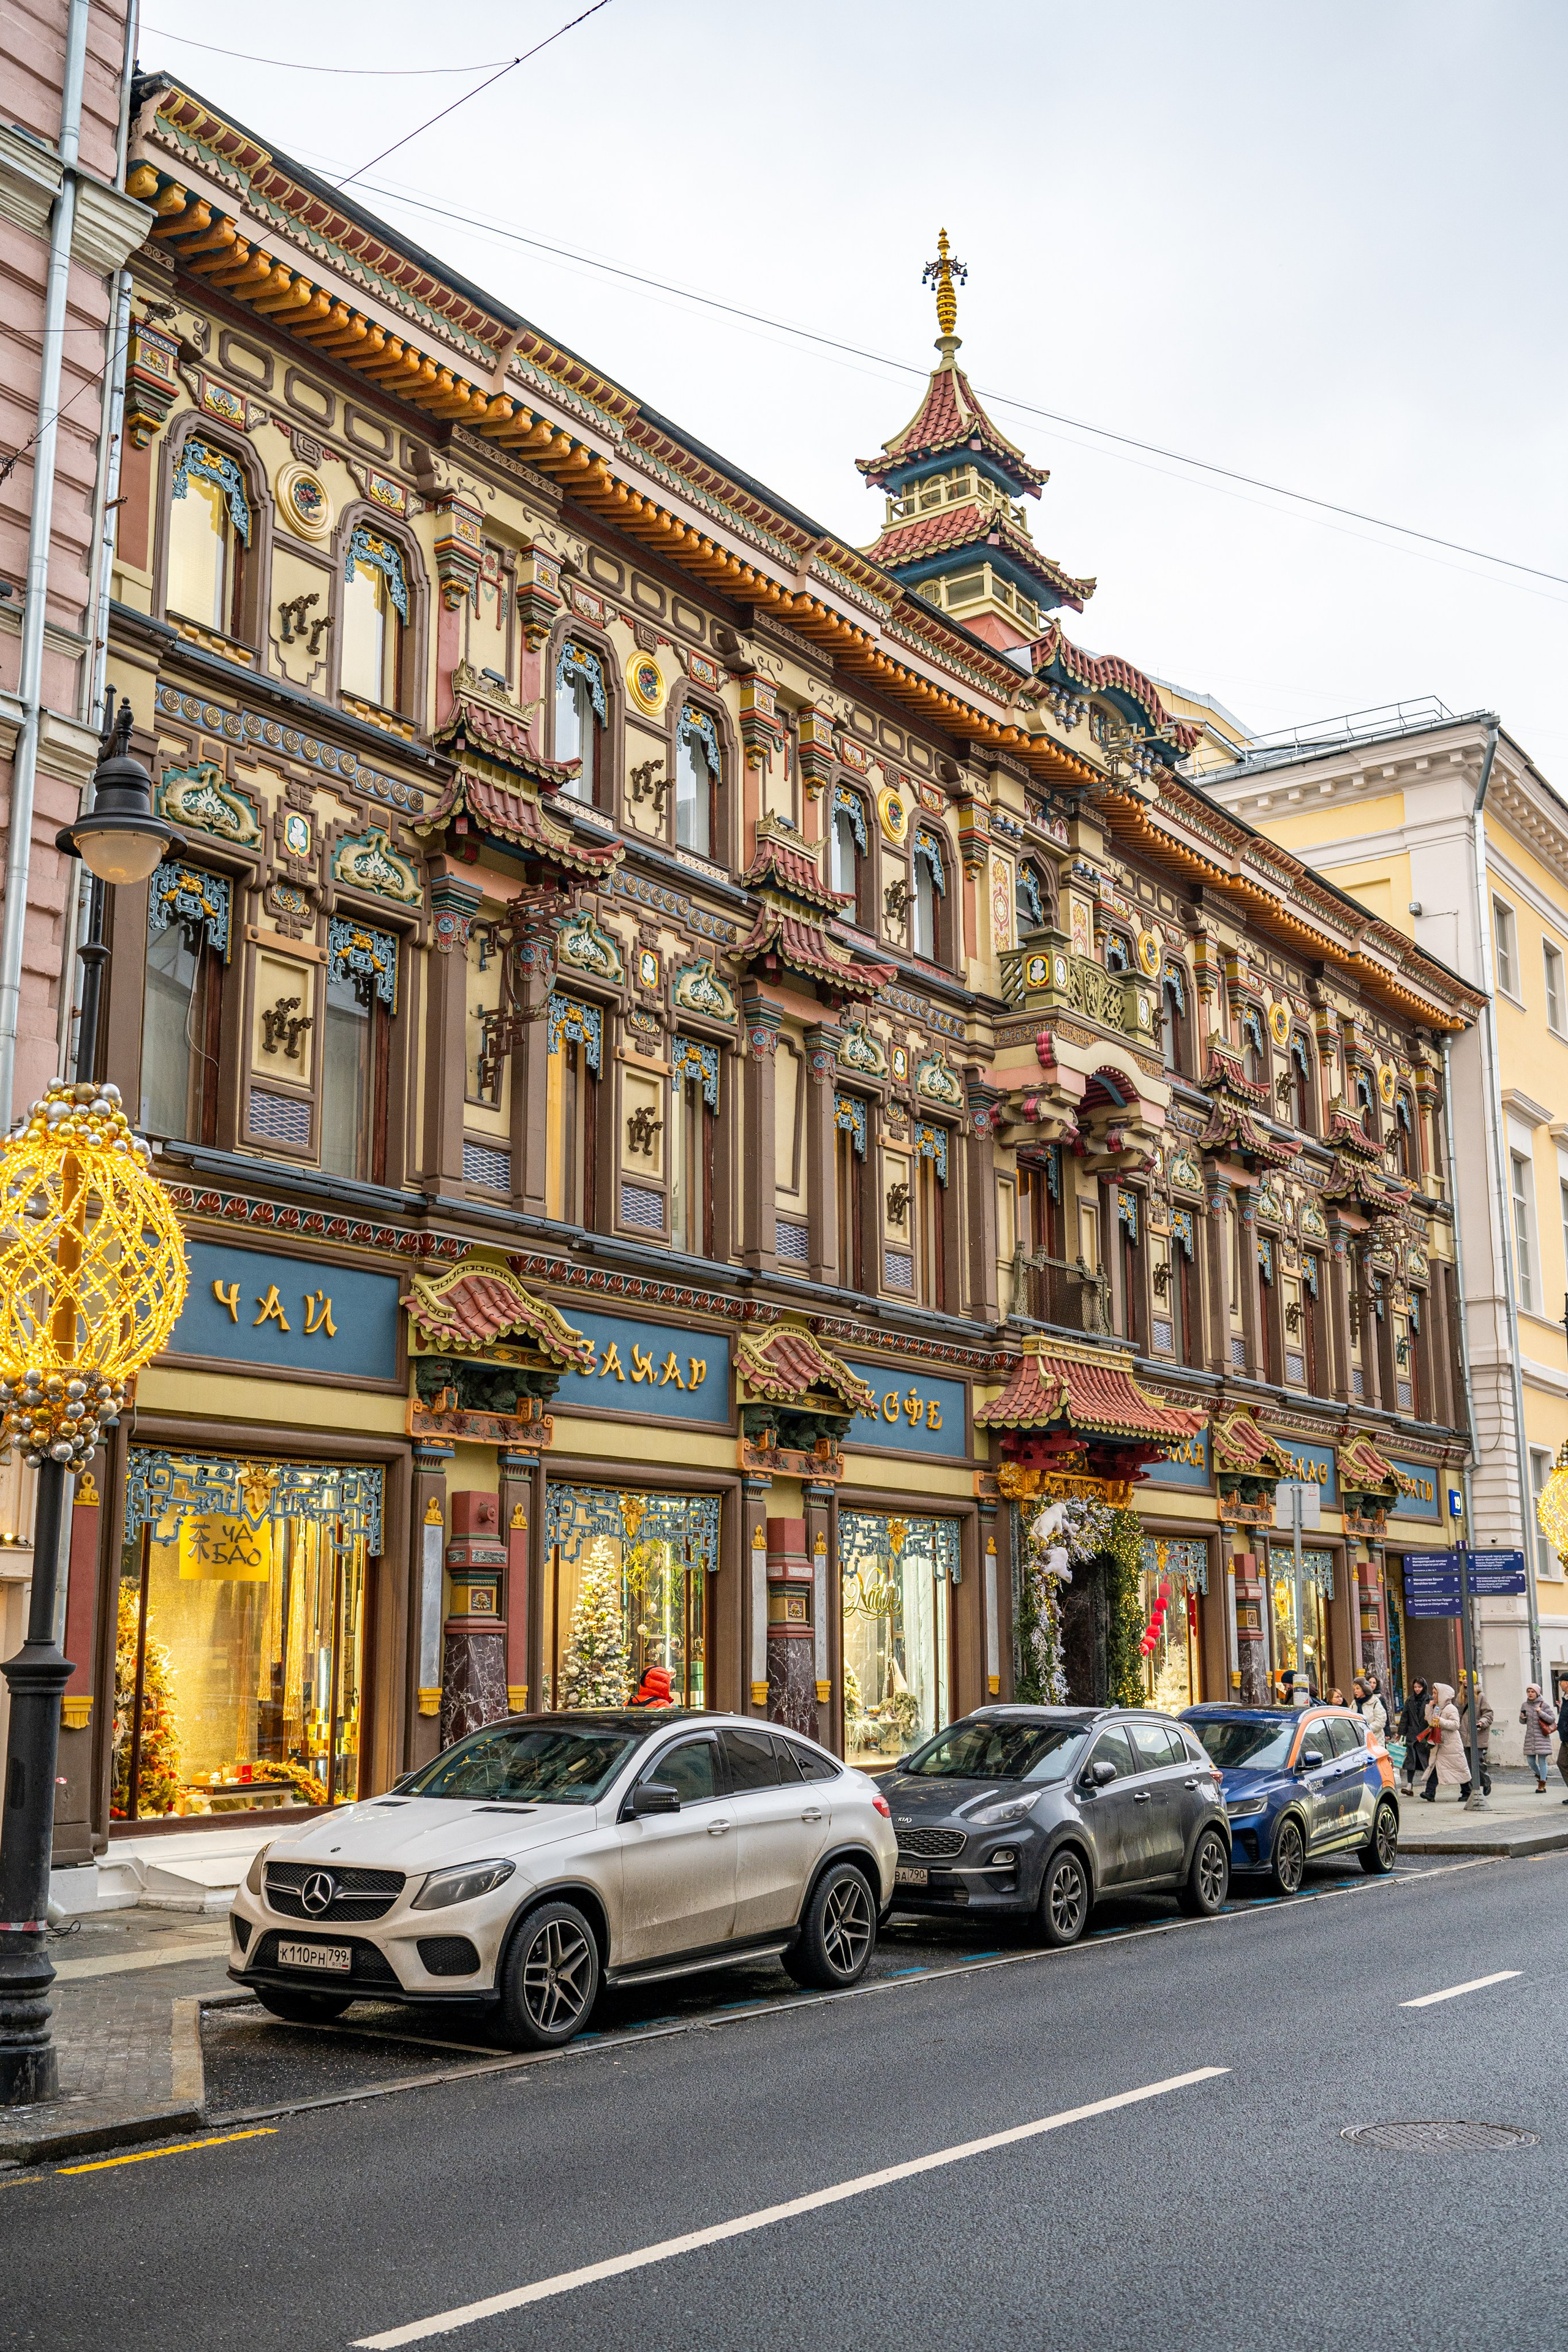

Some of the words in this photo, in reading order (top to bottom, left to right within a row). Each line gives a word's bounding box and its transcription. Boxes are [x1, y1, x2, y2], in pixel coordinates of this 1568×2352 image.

[211, 1280, 338, 1338] ЧАЙ
[1454, 1496, 1461, 1510] 19
[222, 1523, 253, 1543] ЧА
[211, 1542, 262, 1566] БАО
[909, 1869, 924, 1879] 790
[328, 1949, 347, 1962] 799
